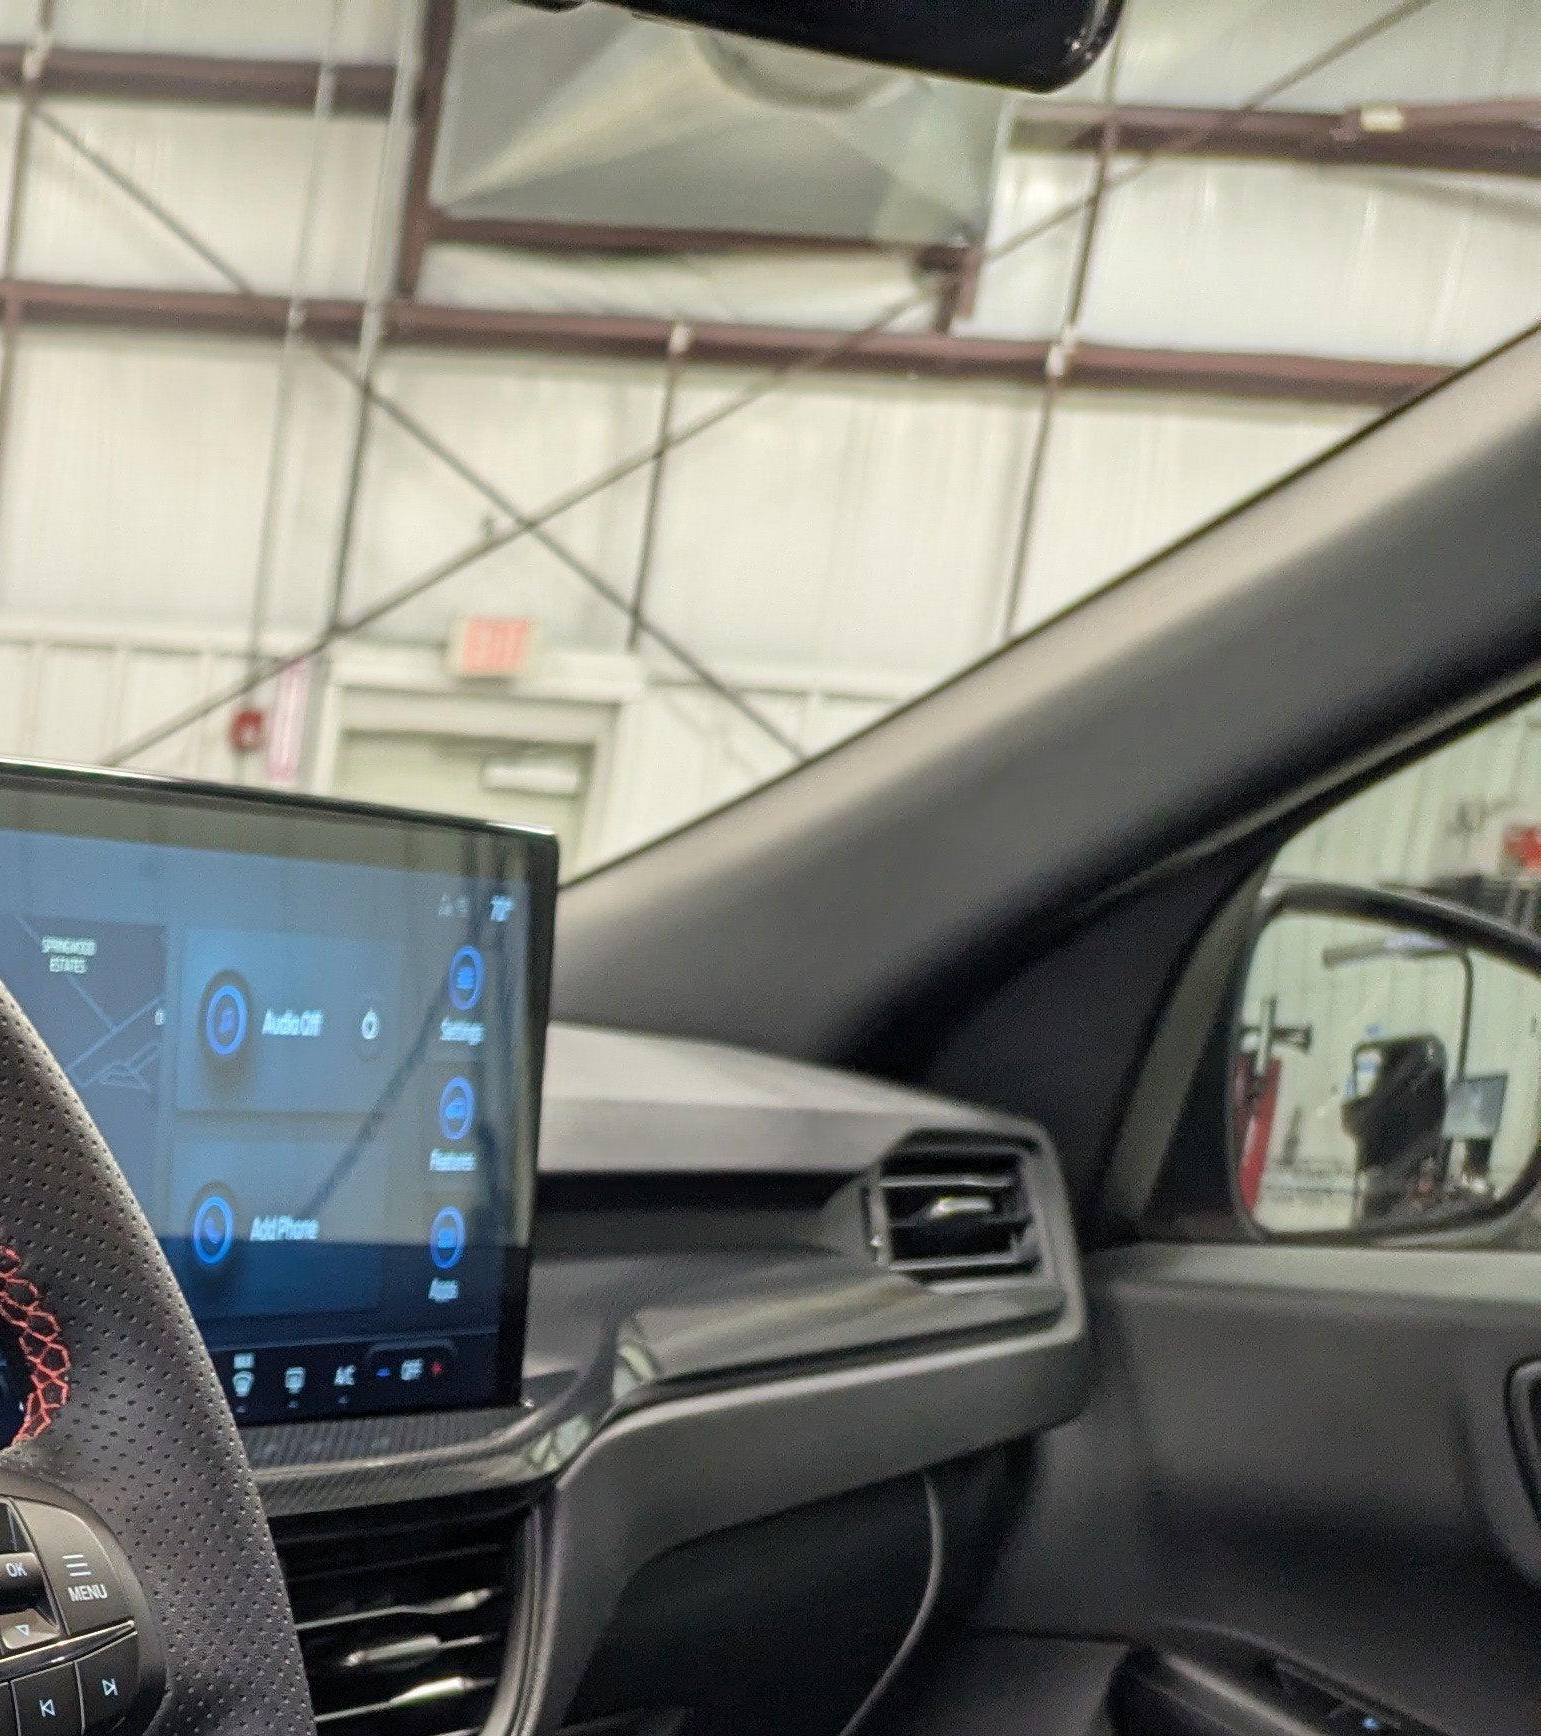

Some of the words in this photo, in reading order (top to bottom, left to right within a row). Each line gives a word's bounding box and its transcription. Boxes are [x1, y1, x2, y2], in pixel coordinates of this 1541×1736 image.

[49, 956, 87, 974] ESTATES
[261, 1008, 300, 1036] Audio
[250, 1216, 276, 1241] Add
[277, 1215, 319, 1240] Phone
[428, 1277, 458, 1303] Apps
[5, 1562, 28, 1578] OK
[67, 1584, 108, 1602] MENU
